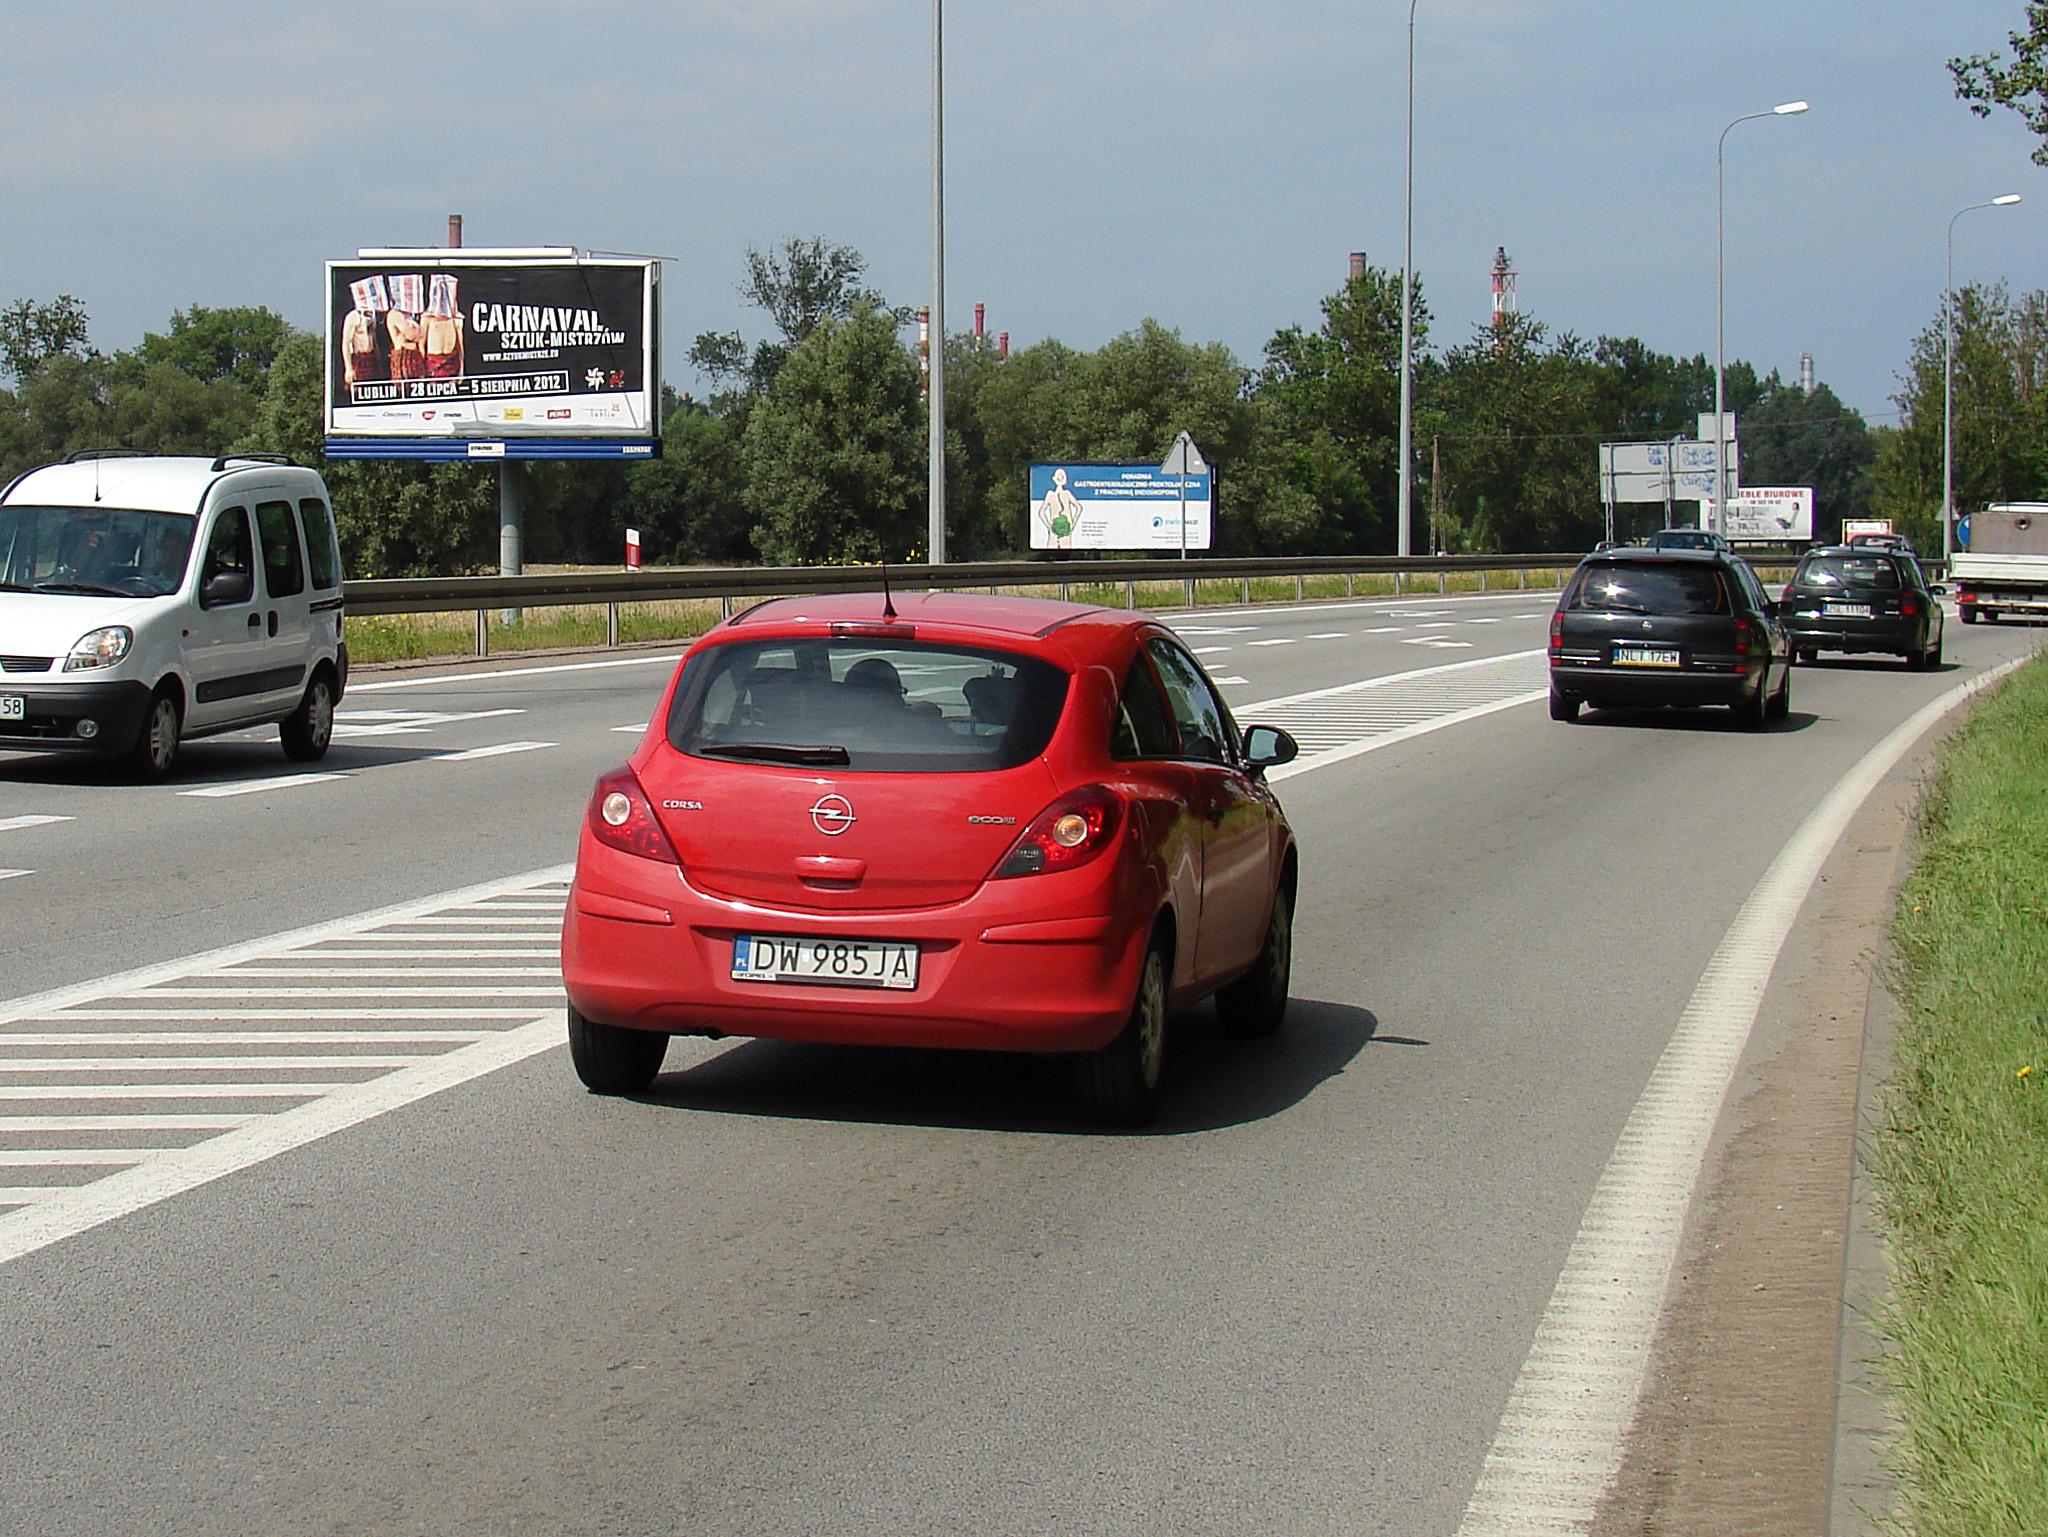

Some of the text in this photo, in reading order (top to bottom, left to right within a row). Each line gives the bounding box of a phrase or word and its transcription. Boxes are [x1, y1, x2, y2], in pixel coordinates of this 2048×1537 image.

[472, 302, 604, 332] CARNAVAL
[358, 385, 398, 400] LUBLIN
[411, 383, 425, 396] 28
[427, 382, 458, 396] LIPCA
[471, 380, 479, 394] 5
[481, 378, 531, 394] SIERPNIA
[534, 375, 561, 390] 2012
[1738, 489, 1804, 498] EBLE BIUROWE
[663, 800, 703, 809] CORSA
[735, 957, 747, 967] PL
[755, 940, 908, 978] DW 985JA
